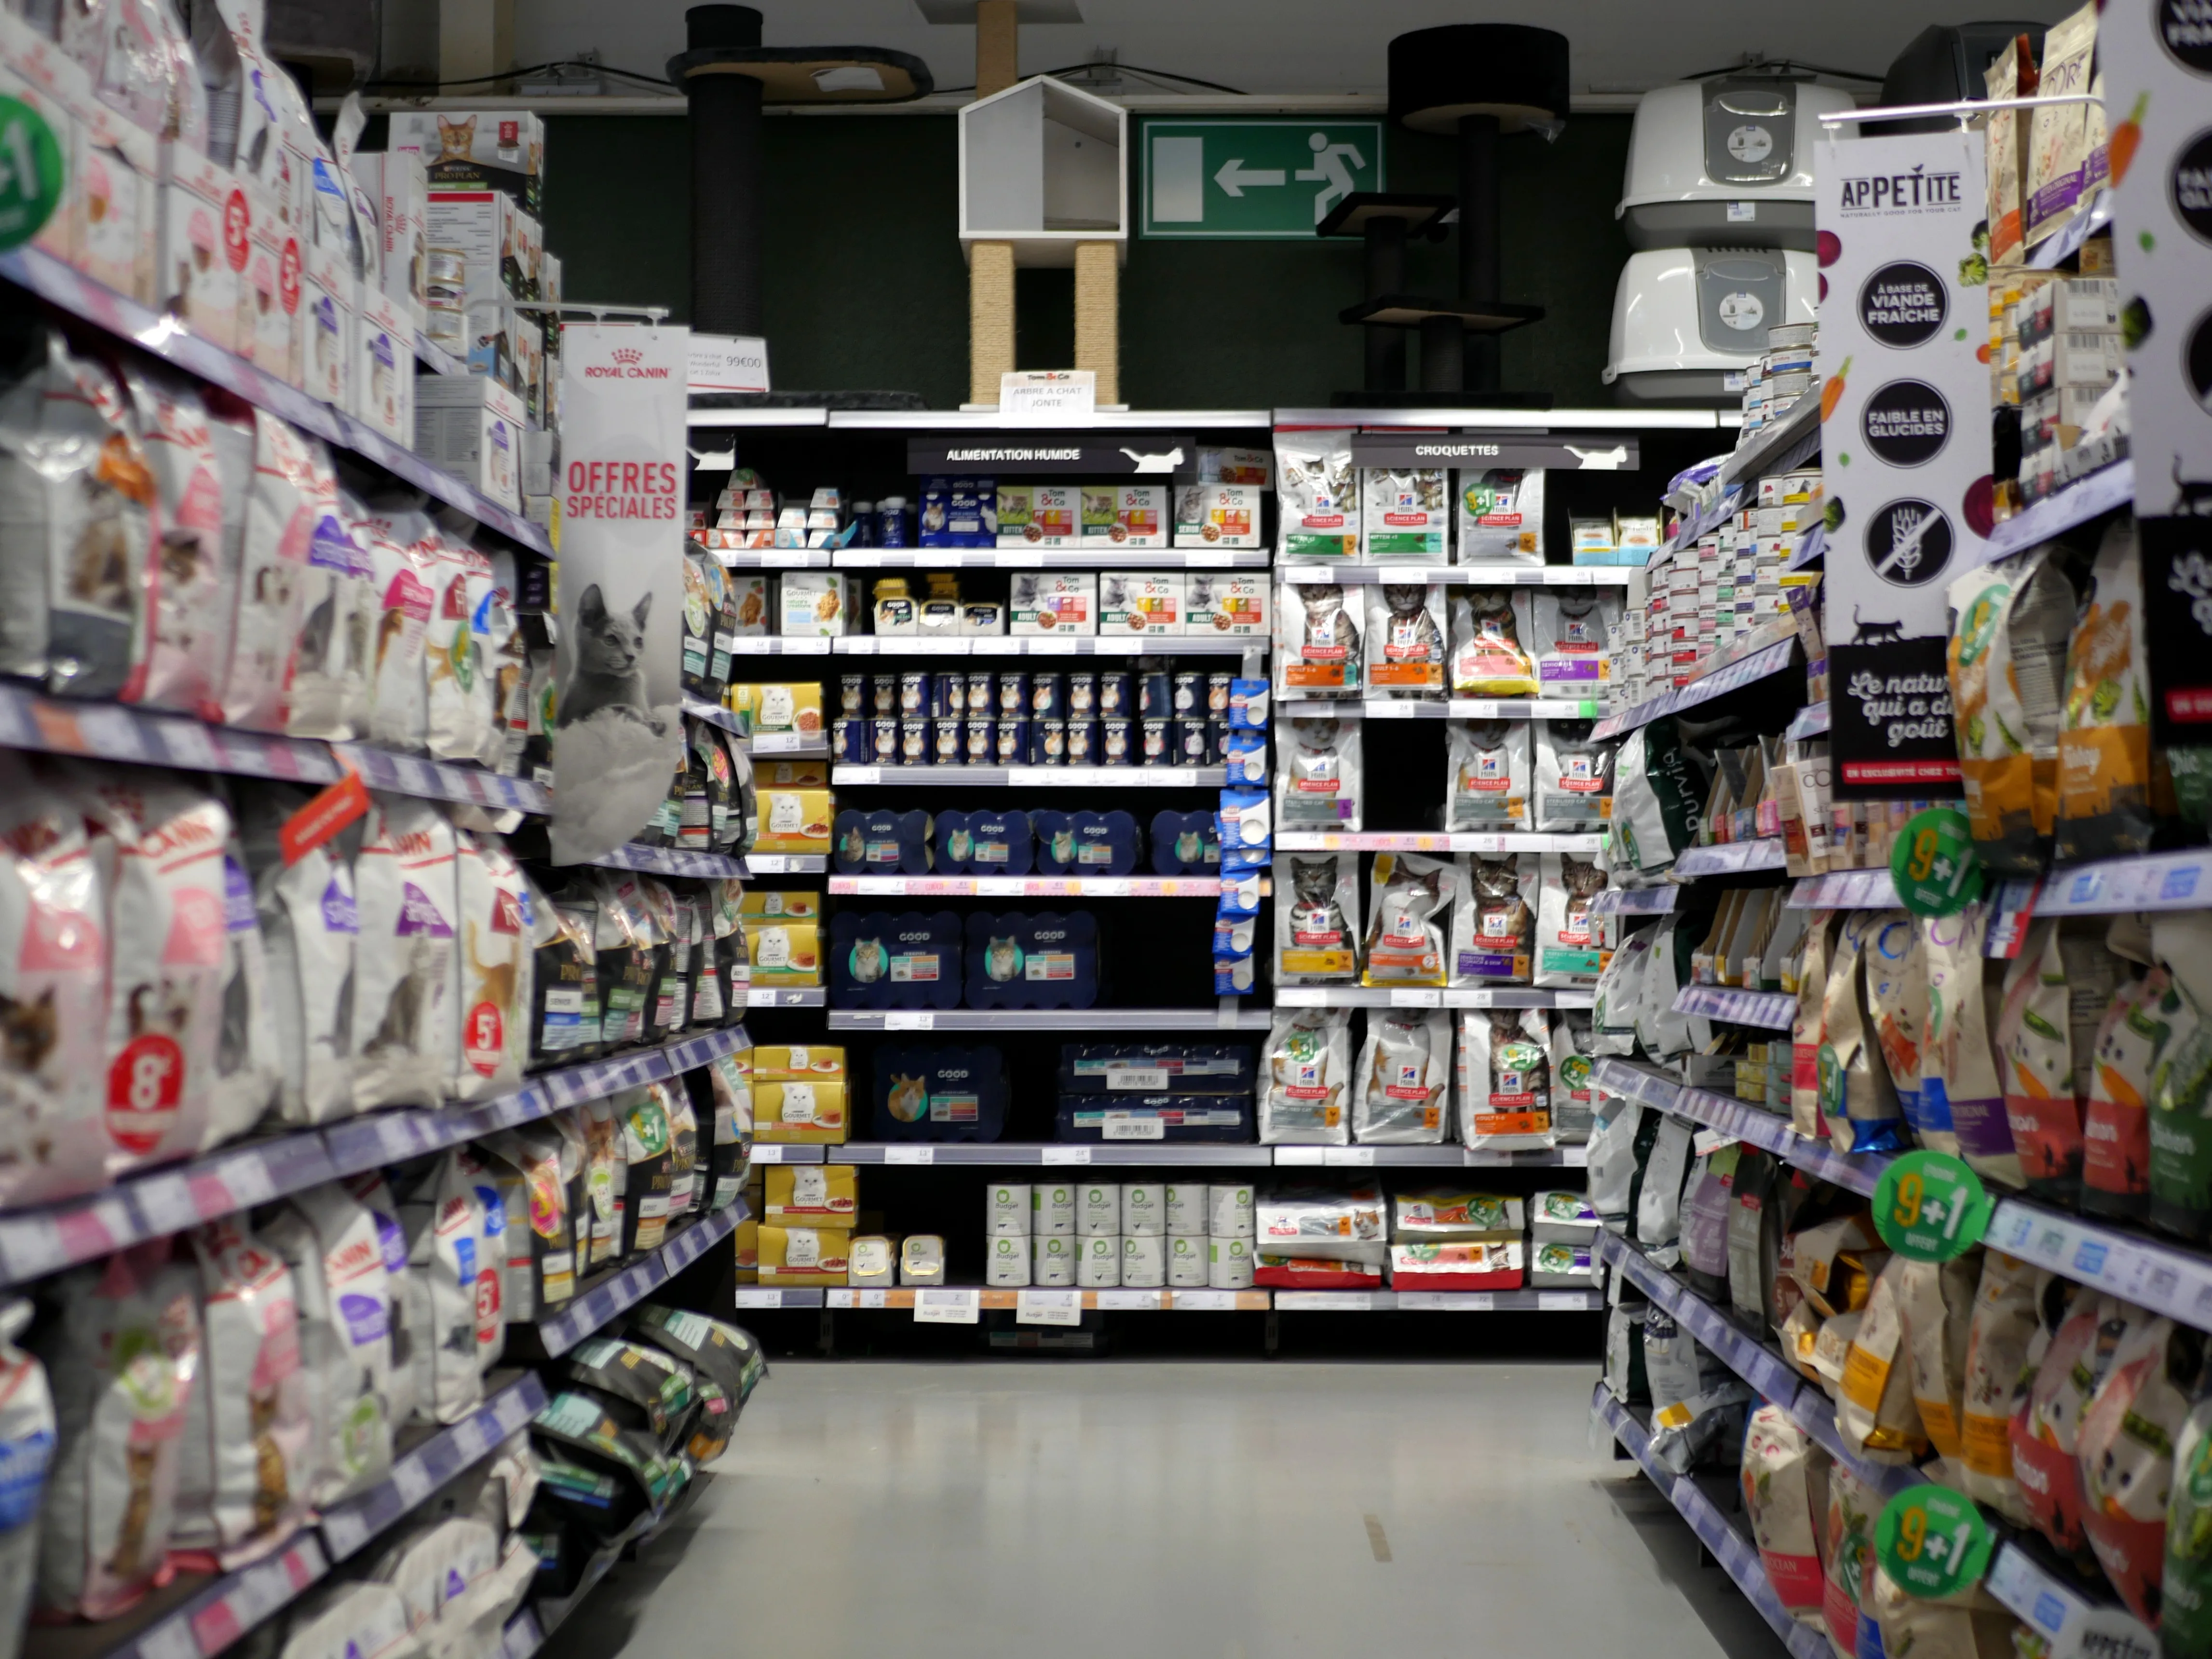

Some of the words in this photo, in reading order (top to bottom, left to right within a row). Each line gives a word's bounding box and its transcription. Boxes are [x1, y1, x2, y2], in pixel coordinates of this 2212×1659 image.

[1887, 285, 1912, 294] BASE
[1915, 284, 1928, 293] DE
[1872, 294, 1935, 309] VIANDE
[1868, 306, 1940, 324] FRAÎCHE
[726, 356, 761, 368] 99€00
[585, 367, 624, 378] ROYAL
[627, 367, 668, 379] CANIN
[1868, 411, 1920, 425] FAIBLE
[1922, 410, 1943, 423] EN
[1869, 422, 1944, 437] GLUCIDES
[947, 449, 1032, 461] ALIMENTATION
[1034, 449, 1080, 460] HUMIDE
[1416, 445, 1499, 457] CROQUETTES
[568, 461, 678, 494] OFFRES
[567, 492, 676, 519] SPÉCIALES
[1054, 498, 1065, 506] Co
[1139, 498, 1150, 506] Co
[1179, 526, 1200, 534] SENIOR
[1847, 672, 1884, 700] Le
[1862, 695, 1906, 726] qui
[1908, 701, 1927, 716] a
[1887, 717, 1949, 748] goût
[1909, 829, 1975, 898] 9+1
[899, 932, 930, 941] GOOD
[1034, 931, 1065, 940] GOOD
[937, 1070, 968, 1079] GOOD
[1893, 1172, 1968, 1240] 9+1
[1897, 1506, 1971, 1576] 9+1
